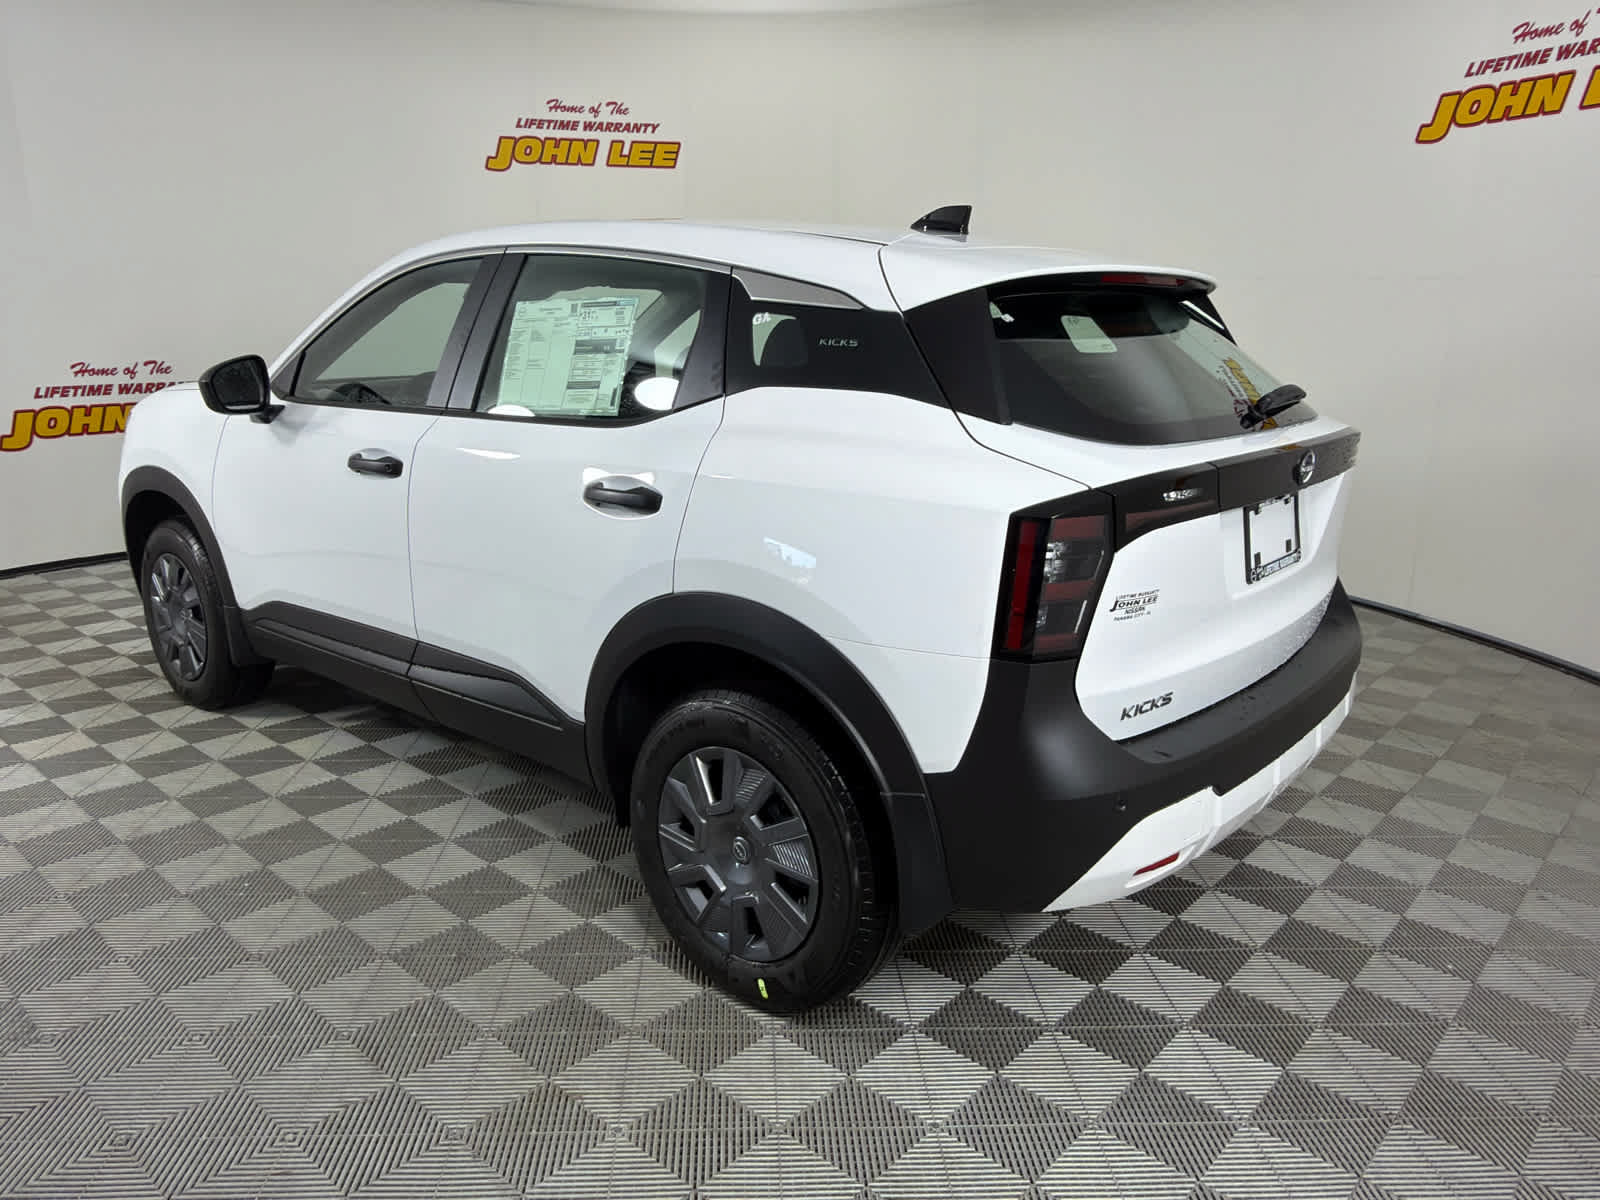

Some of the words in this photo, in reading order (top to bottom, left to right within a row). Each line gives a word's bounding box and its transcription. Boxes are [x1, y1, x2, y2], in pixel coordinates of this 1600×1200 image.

[1512, 21, 1565, 44] Home
[1569, 9, 1591, 37] of
[1464, 47, 1553, 78] LIFETIME
[546, 98, 585, 114] Home
[589, 102, 601, 118] of
[605, 101, 630, 116] The
[1415, 70, 1577, 144] JOHN
[515, 117, 580, 132] LIFETIME
[582, 120, 660, 134] WARRANTY
[485, 135, 600, 172] JOHN
[606, 140, 681, 169] LEE
[819, 339, 858, 347] KICKS
[70, 361, 119, 377] Home
[123, 362, 138, 380] of
[143, 360, 173, 375] The
[33, 383, 113, 400] LIFETIME
[0, 402, 138, 451] JOHN
[1109, 600, 1140, 612] JOHN
[1142, 596, 1158, 605] LEE
[1120, 691, 1174, 721] KICKS
